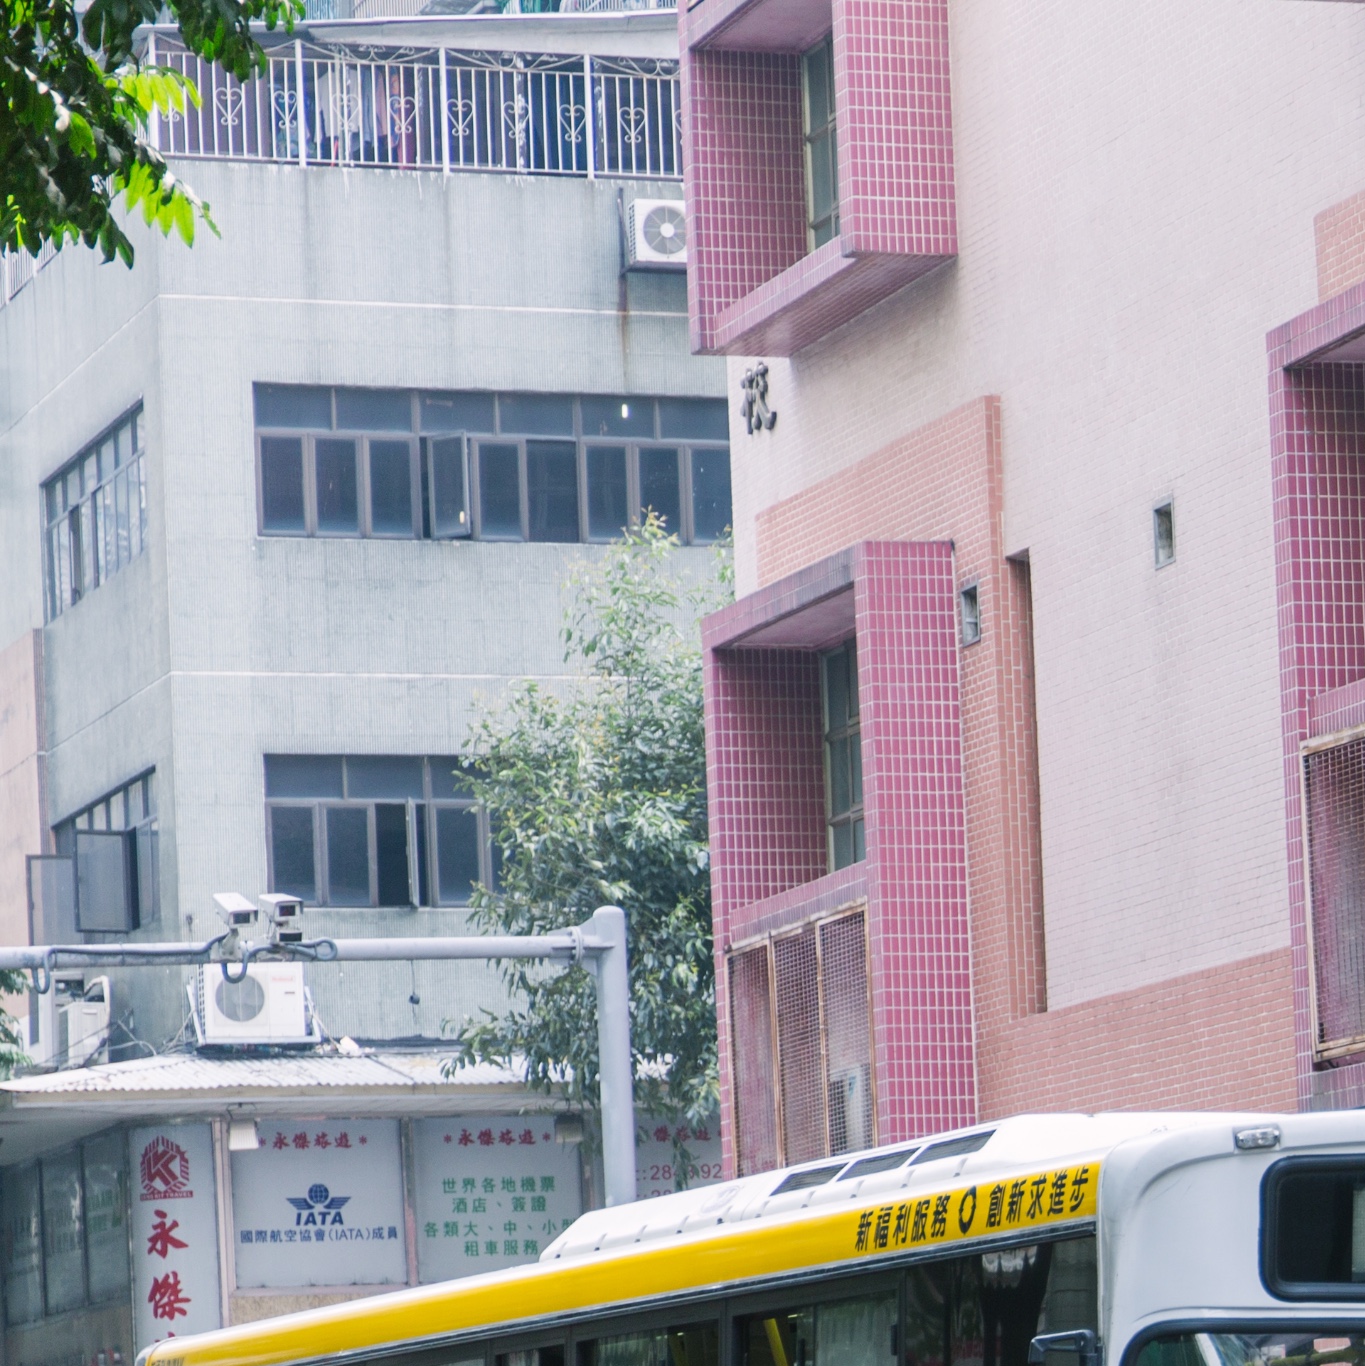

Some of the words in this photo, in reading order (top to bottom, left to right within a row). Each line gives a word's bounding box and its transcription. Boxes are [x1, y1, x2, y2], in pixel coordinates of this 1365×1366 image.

[442, 1175, 556, 1195] 世界各地機票
[295, 1211, 345, 1226] IATA
[855, 1193, 951, 1251] 新福利服務
[985, 1166, 1090, 1228] 創新求進步
[463, 1238, 539, 1257] 租車服務
[147, 1209, 192, 1343] 永傑
